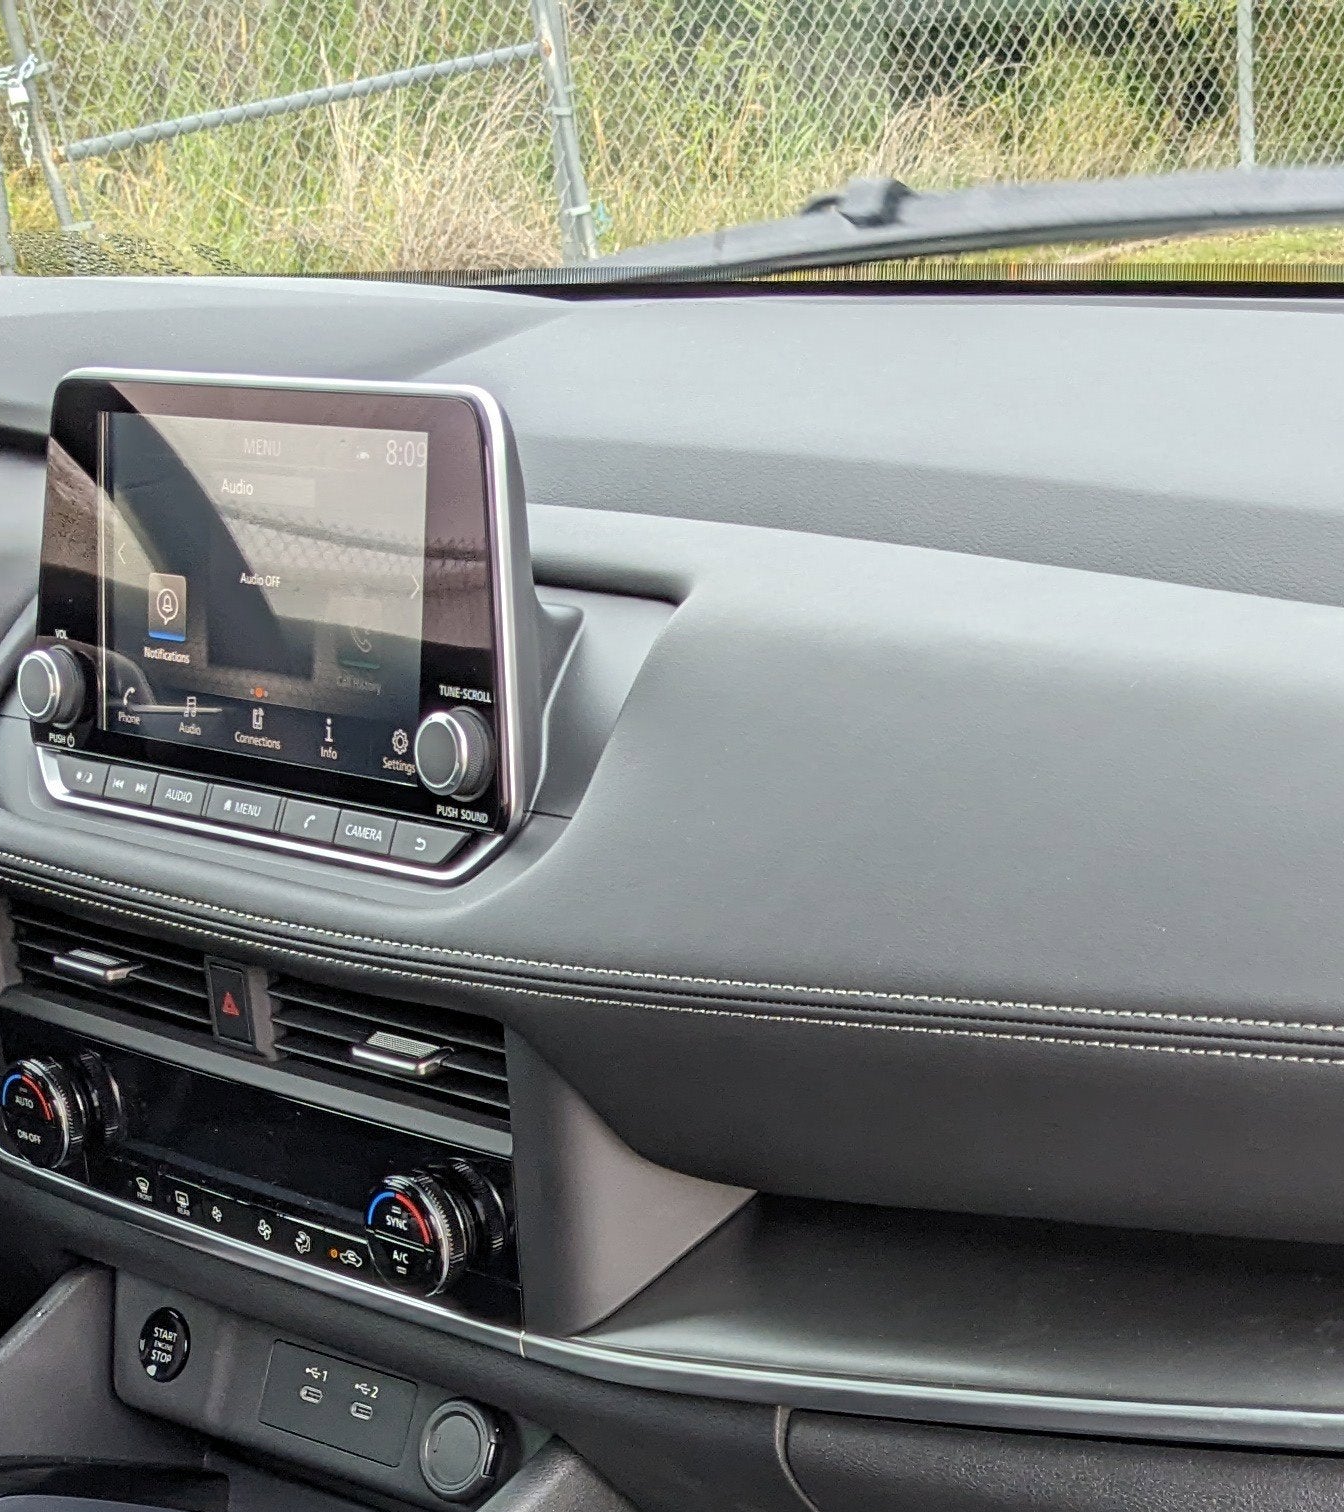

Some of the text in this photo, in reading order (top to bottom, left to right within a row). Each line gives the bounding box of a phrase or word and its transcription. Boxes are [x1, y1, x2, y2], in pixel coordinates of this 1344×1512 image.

[242, 438, 427, 467] MENU 8:09
[221, 478, 254, 496] Audio
[240, 572, 280, 588] Audio OFF
[54, 629, 68, 640] VOL
[143, 646, 190, 664] Notifications
[48, 733, 66, 745] PUSH
[118, 711, 416, 776] Phone Audio Connections Info Settings
[165, 789, 193, 803] AUDIO
[235, 802, 262, 817] MENU
[436, 804, 488, 824] PUSH SOUND
[345, 824, 382, 842] CAMERA
[15, 1095, 34, 1109] AUTO
[386, 1215, 408, 1231] SYNC
[393, 1250, 409, 1264] A/C
[154, 1327, 178, 1343] START
[151, 1350, 172, 1364] STOP
